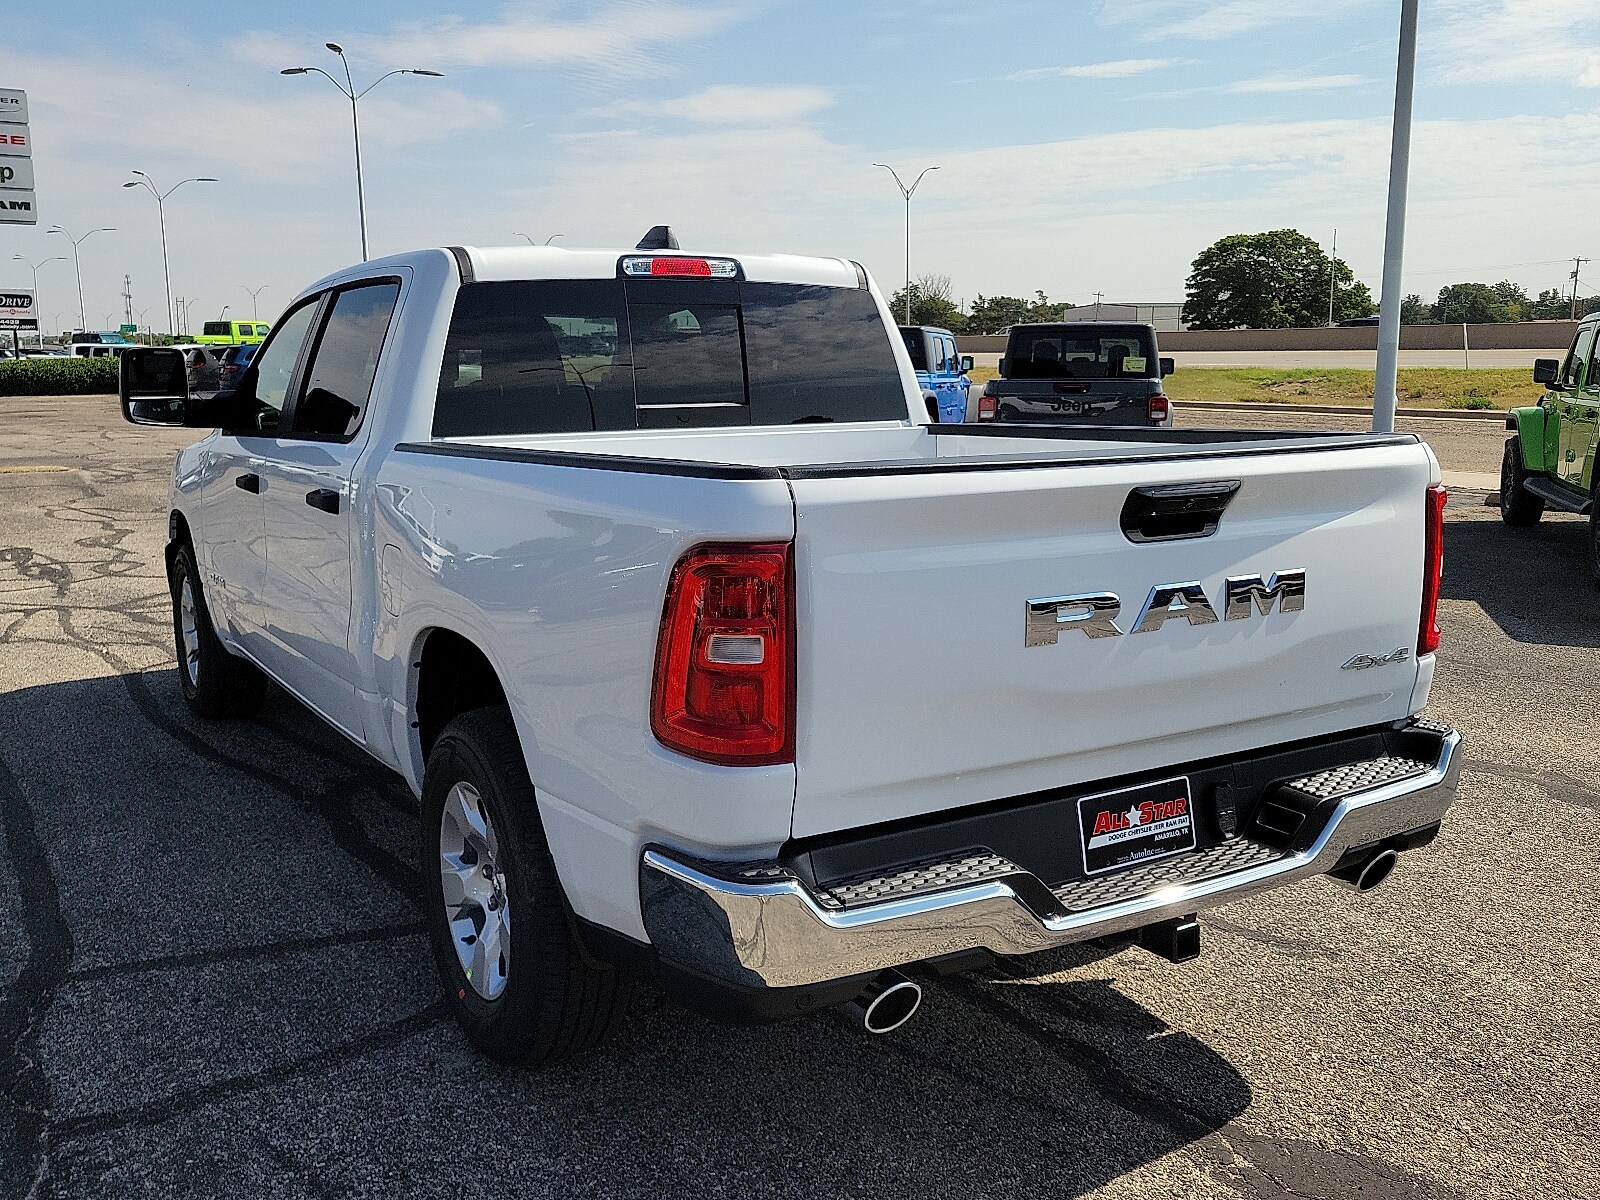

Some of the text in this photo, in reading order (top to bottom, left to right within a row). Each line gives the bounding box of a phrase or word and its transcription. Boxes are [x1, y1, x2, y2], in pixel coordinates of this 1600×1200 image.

[1050, 399, 1092, 414] Jeep
[1025, 567, 1306, 648] RAM
[1108, 831, 1127, 842] DODGE
[1127, 825, 1153, 838] CHRYSLER
[1165, 819, 1178, 829] RAM
[1177, 816, 1188, 825] FIAT
[1181, 827, 1189, 835] TX
